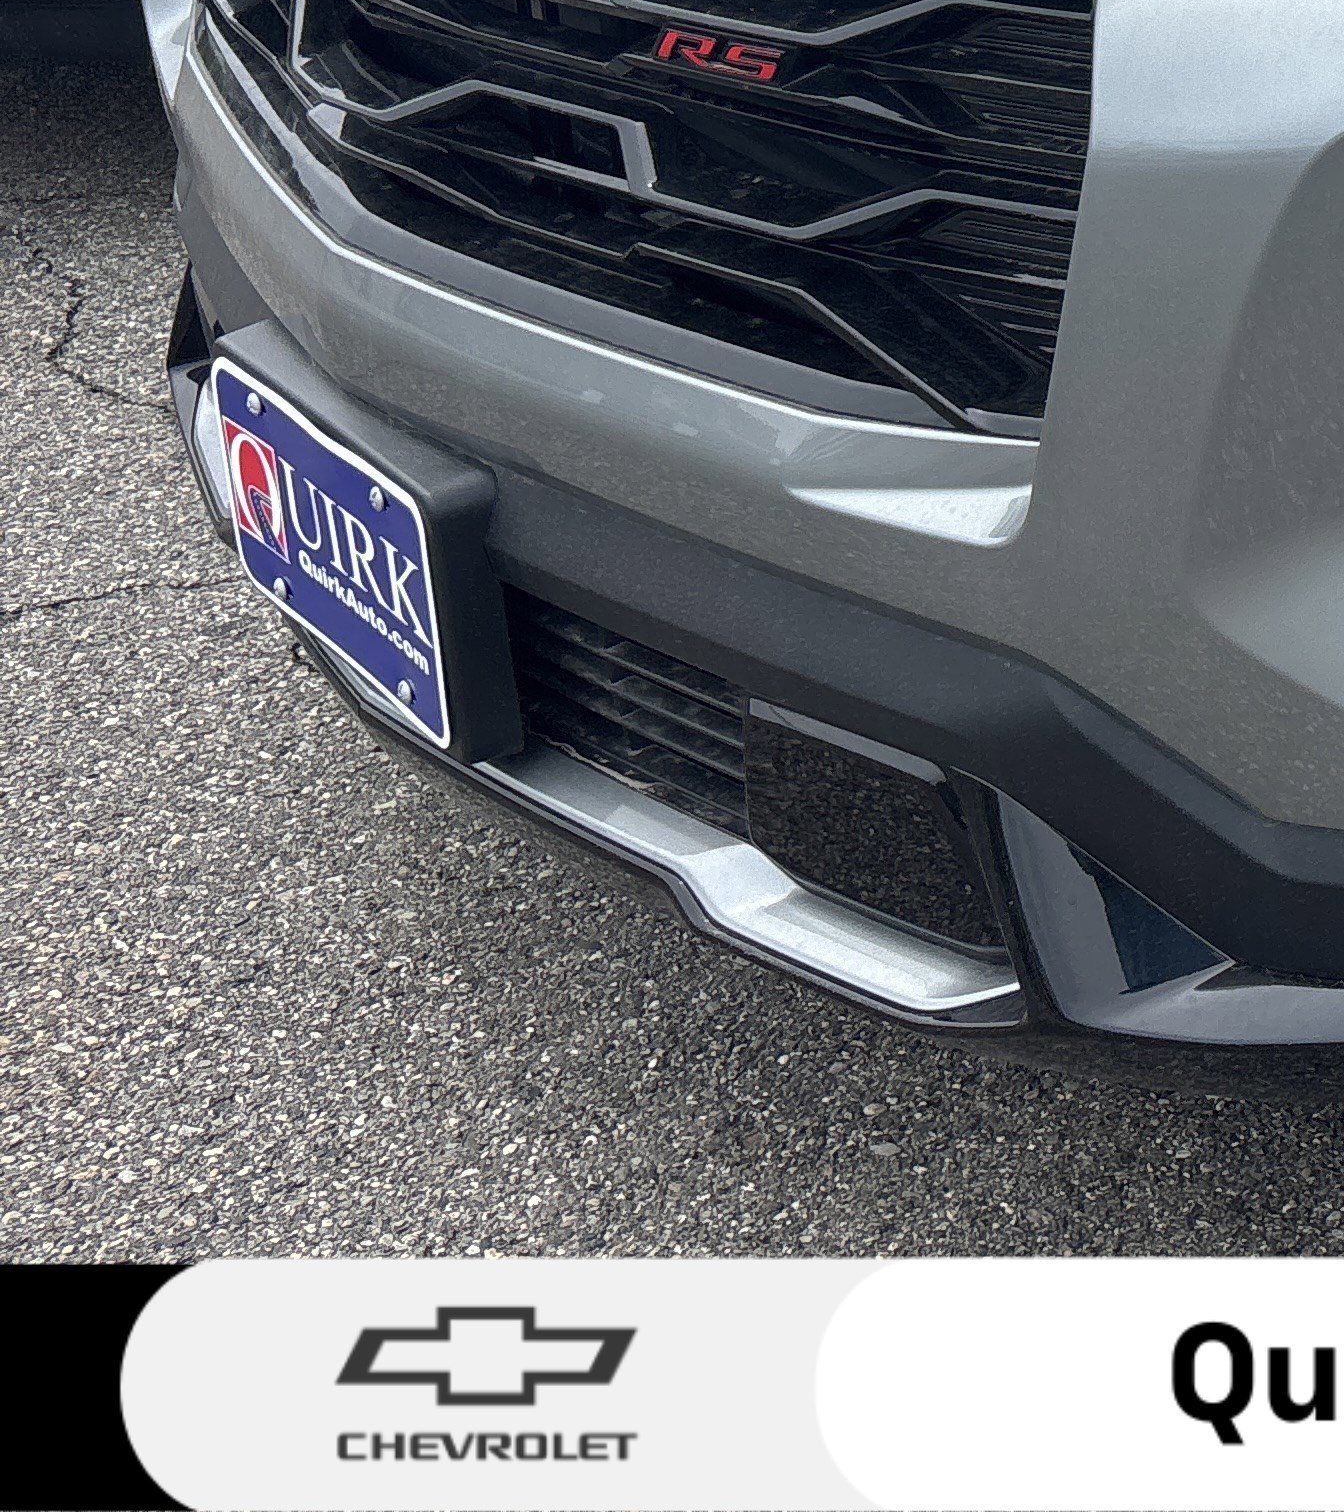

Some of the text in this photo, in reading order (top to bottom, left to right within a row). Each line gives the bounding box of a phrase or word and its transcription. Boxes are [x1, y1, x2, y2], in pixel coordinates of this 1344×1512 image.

[658, 28, 785, 81] RS
[230, 433, 434, 649] QUIRK
[298, 549, 431, 676] QuirkAuto.com
